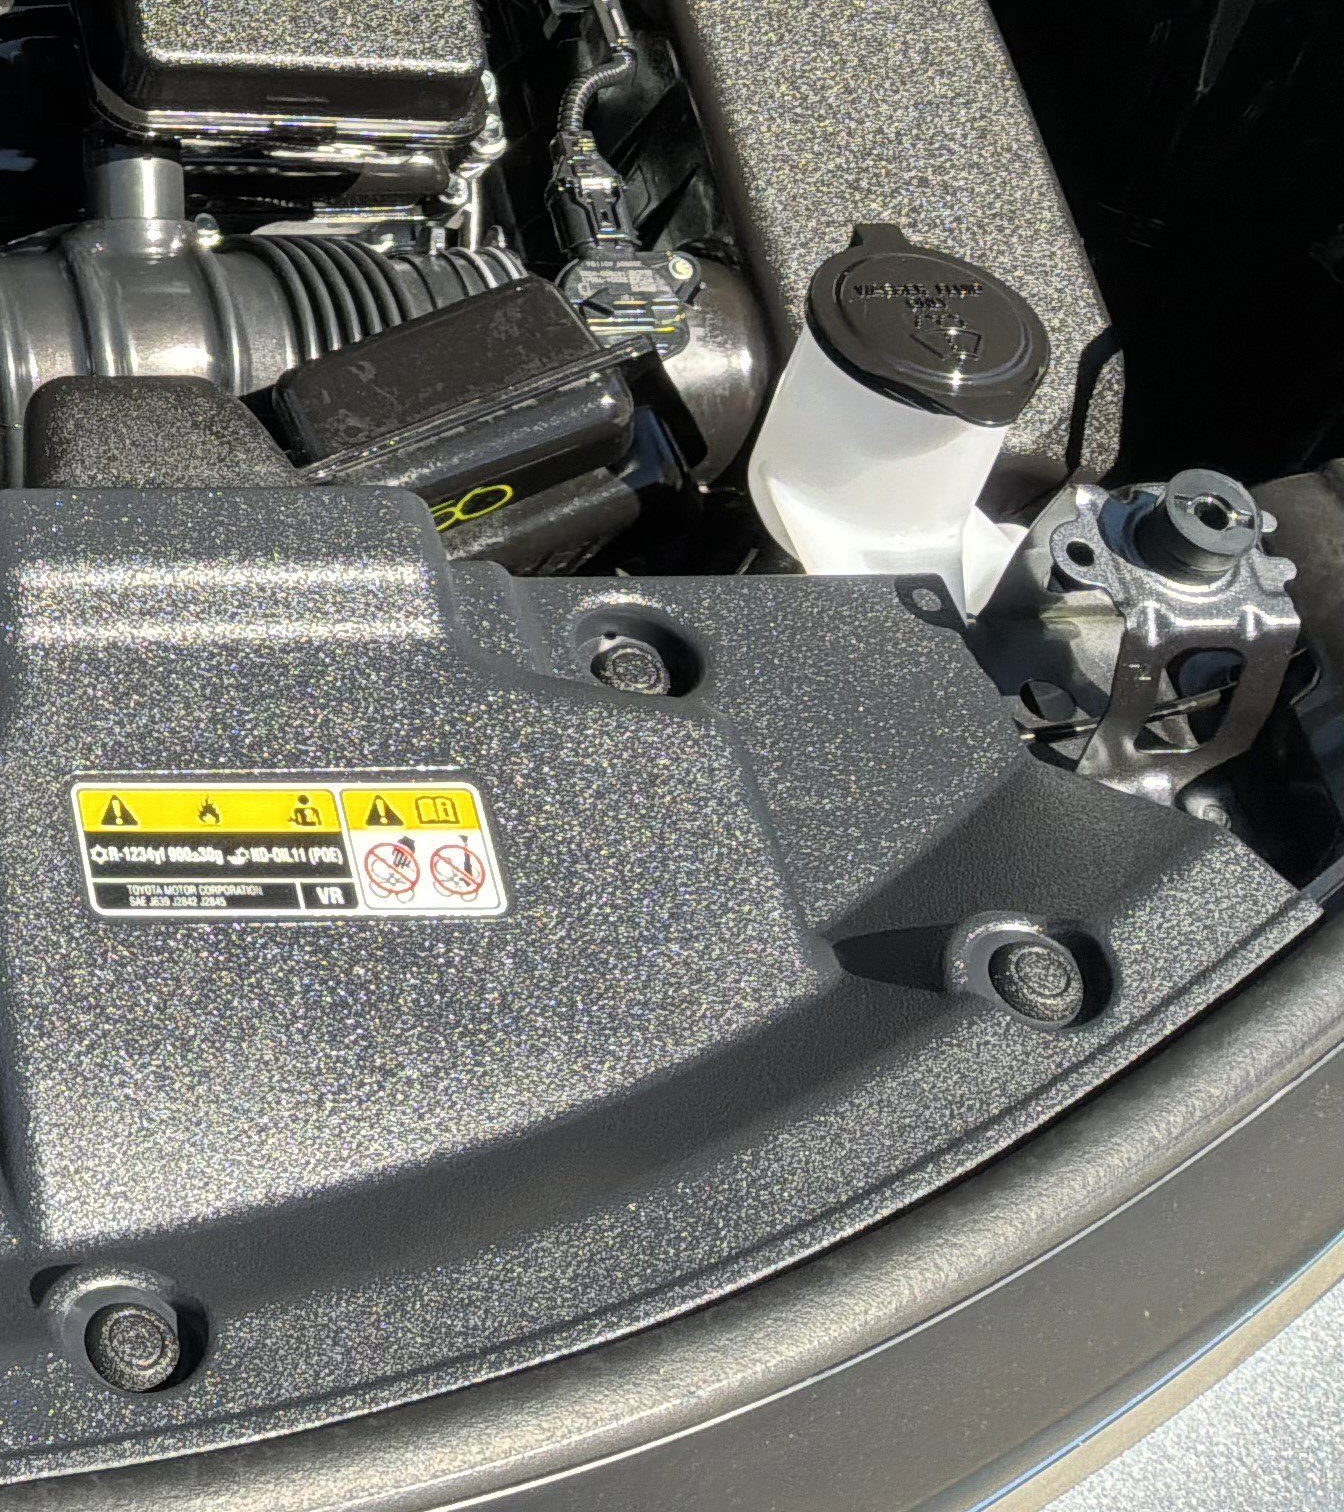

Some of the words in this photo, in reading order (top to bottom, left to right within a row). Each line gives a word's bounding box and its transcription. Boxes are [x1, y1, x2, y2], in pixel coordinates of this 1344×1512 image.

[308, 846, 343, 865] (POE)
[126, 884, 163, 896] TOYOTA
[164, 884, 197, 896] MOTOR
[198, 884, 264, 896] CORPORATION
[315, 887, 345, 906] VR
[128, 895, 148, 907] SAE
